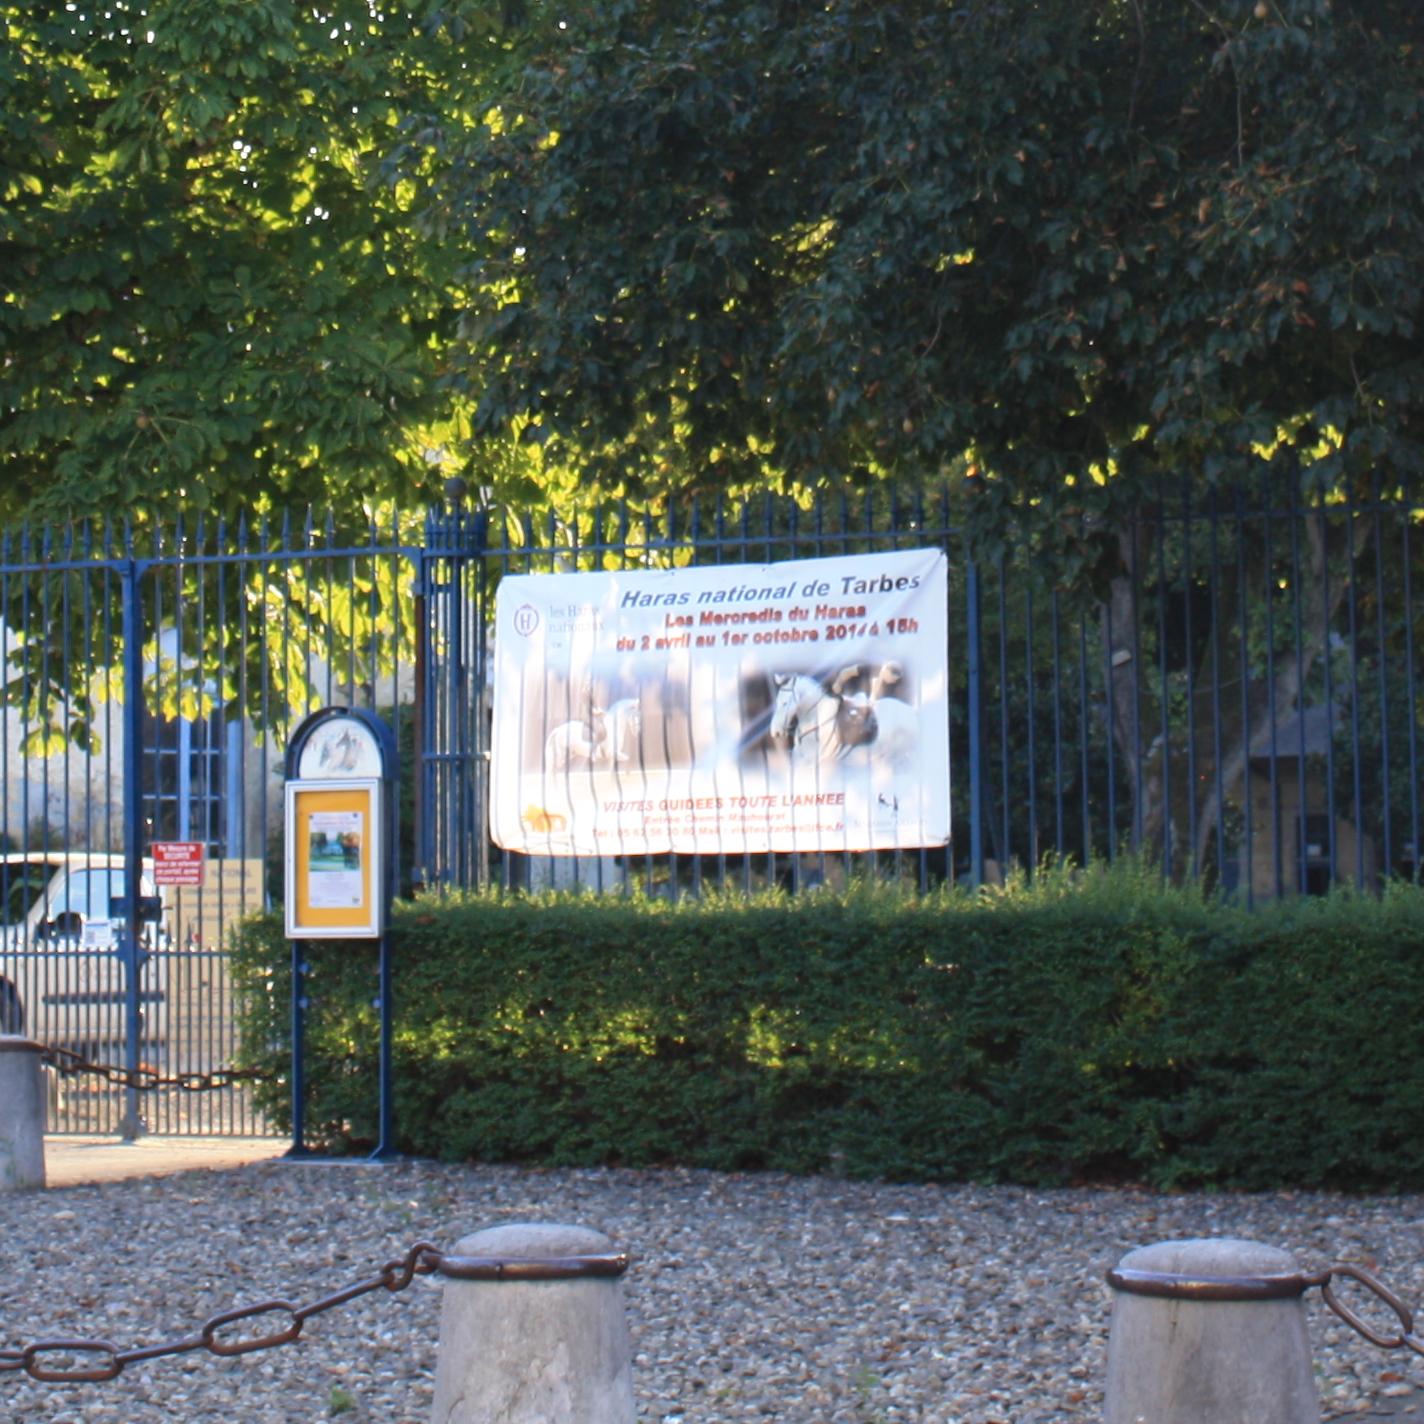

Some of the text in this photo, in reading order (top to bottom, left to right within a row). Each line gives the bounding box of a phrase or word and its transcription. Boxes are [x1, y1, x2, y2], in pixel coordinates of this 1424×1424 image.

[621, 574, 921, 608] Haras national de Tarbes
[665, 605, 866, 628] Les Mercredis du Haras
[616, 636, 635, 653] du
[641, 635, 650, 651] 2
[655, 633, 691, 650] avril
[695, 634, 716, 648] au
[722, 630, 748, 647] 1er
[752, 627, 819, 644] octobre
[886, 617, 919, 635] 15h
[603, 799, 654, 812] VISITES
[658, 797, 723, 812] GUIDEES
[729, 795, 777, 808] TOUTE
